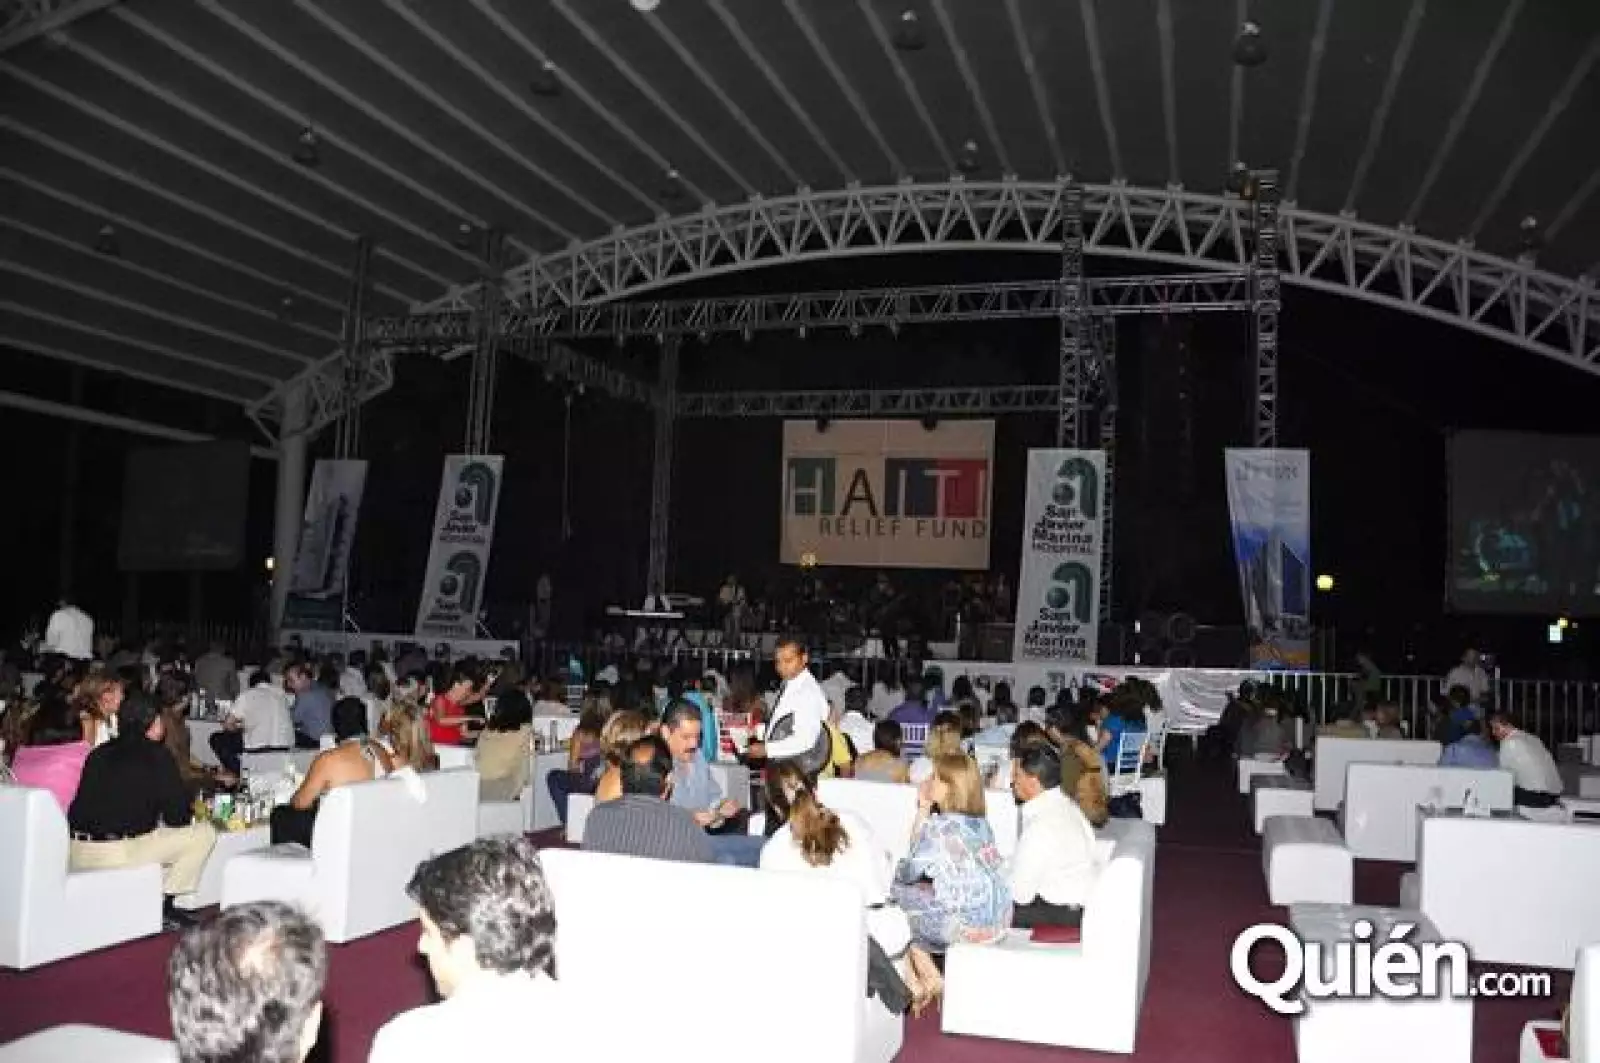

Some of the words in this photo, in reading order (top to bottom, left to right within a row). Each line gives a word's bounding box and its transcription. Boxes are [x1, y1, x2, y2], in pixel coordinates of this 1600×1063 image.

[788, 466, 986, 519] HAITI
[1045, 503, 1080, 519] San
[819, 518, 901, 537] RELIEF
[916, 519, 986, 539] FUND
[1032, 528, 1093, 544] Marina
[1040, 607, 1071, 621] San
[1027, 619, 1080, 634] Javier
[1024, 632, 1085, 648] Marina
